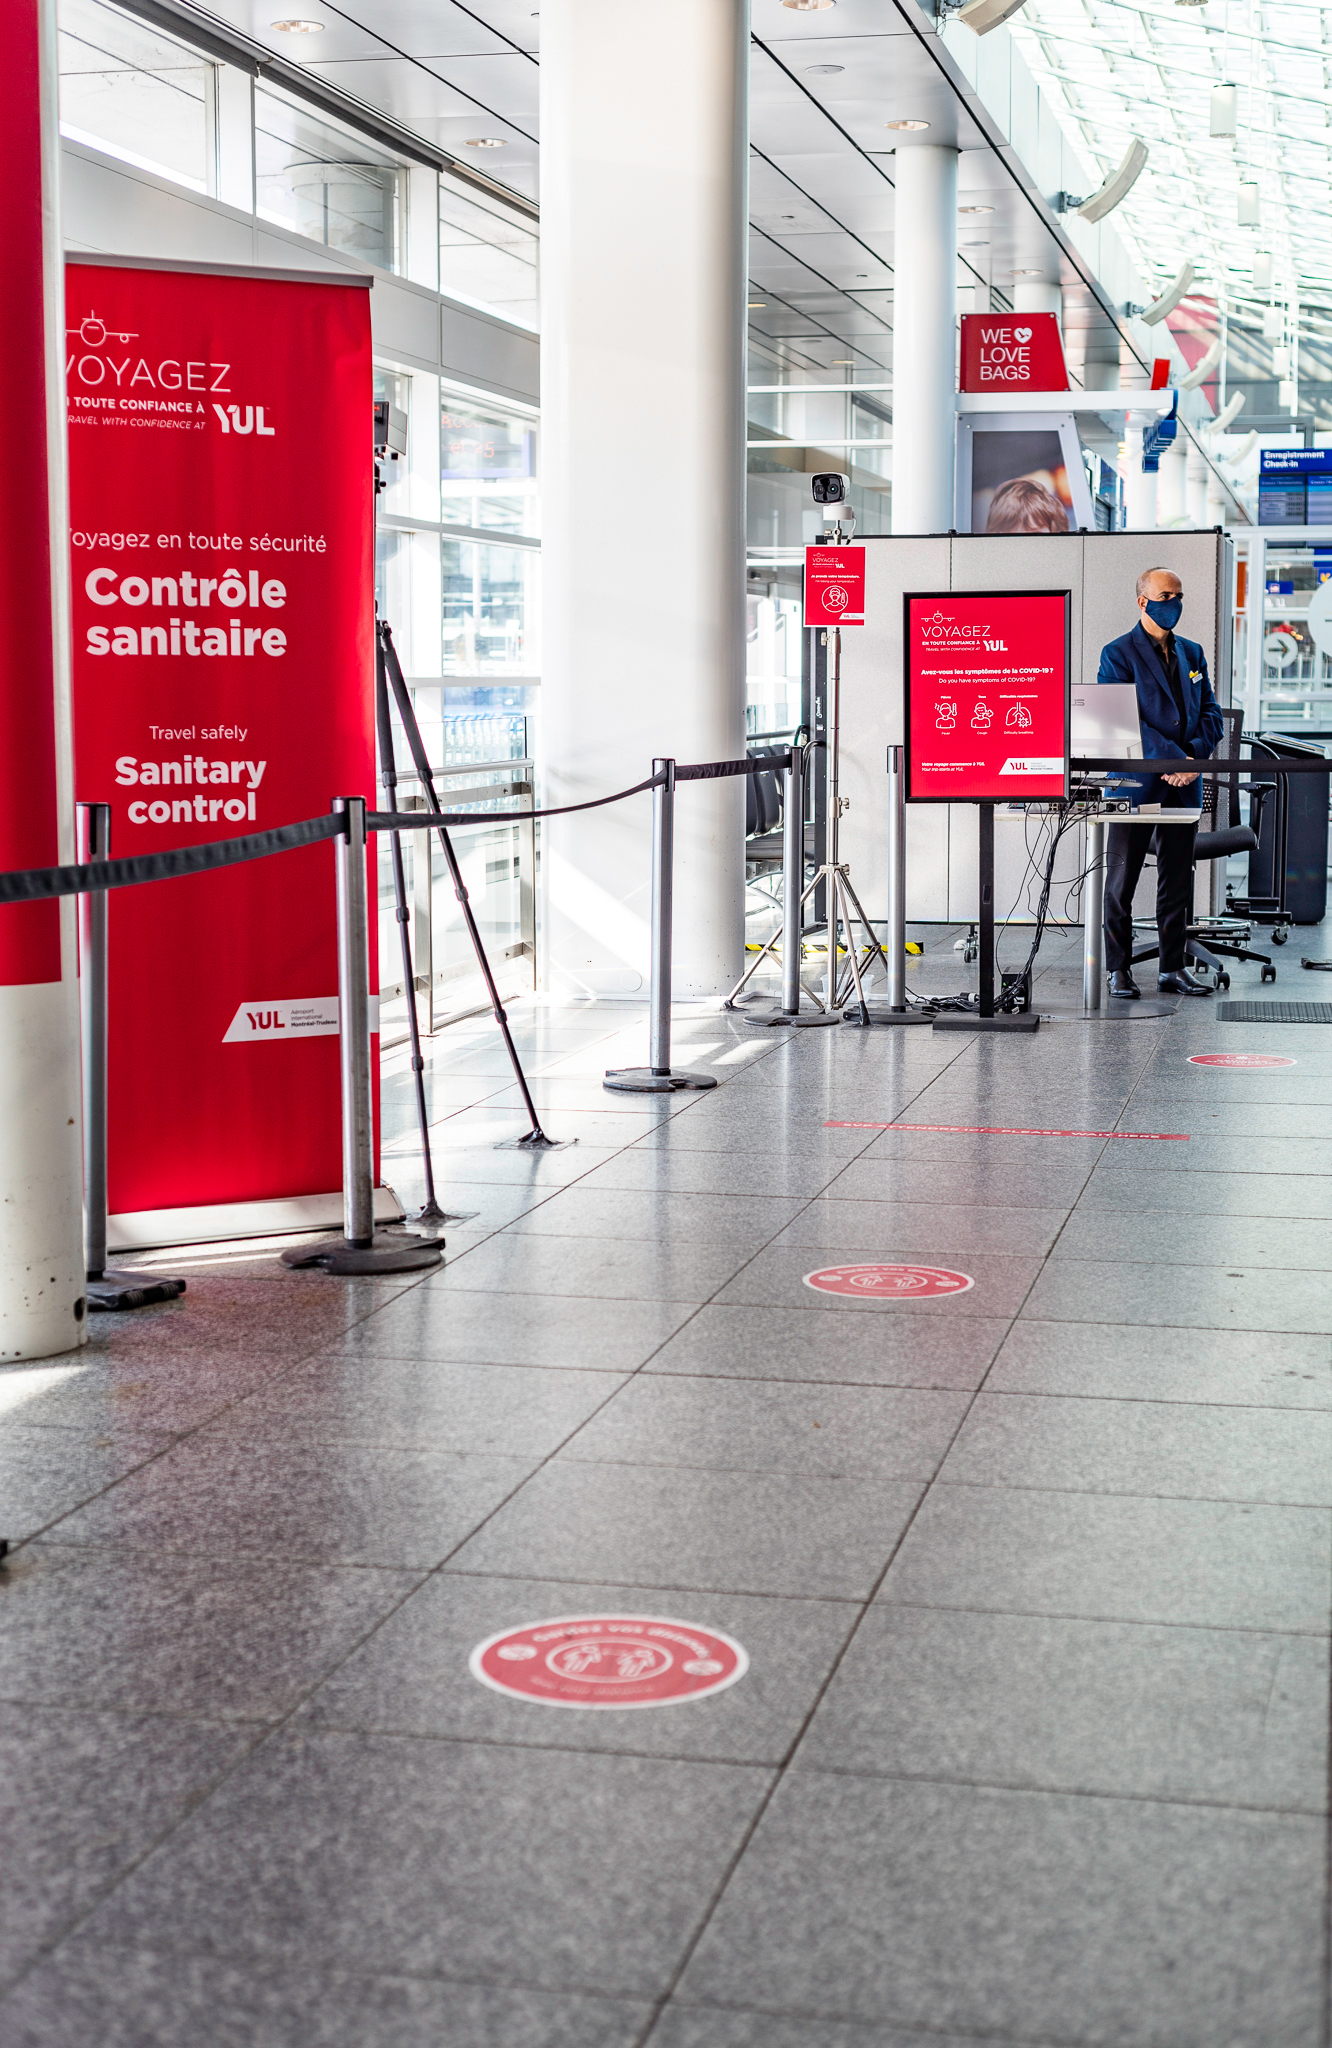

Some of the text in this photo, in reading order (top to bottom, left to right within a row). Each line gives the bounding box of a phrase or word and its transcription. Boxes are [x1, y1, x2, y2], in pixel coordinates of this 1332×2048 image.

[980, 328, 1012, 344] WE
[980, 346, 1031, 364] LOVE
[980, 365, 1031, 381] BAGS
[73, 396, 116, 409] TOUTE
[119, 399, 193, 414] CONFIANCE
[196, 401, 205, 414] À
[68, 414, 206, 430] RAVEL WITH CONFIDENCE AT
[212, 403, 275, 436] YUL
[1264, 451, 1325, 460] Enregistrement
[1263, 460, 1299, 469] Check-in
[69, 529, 327, 553] oyagez en toute sécurité
[85, 567, 287, 608] Contrôle
[86, 618, 288, 657] sanitaire
[921, 626, 991, 637] VOYAGEZ
[983, 640, 1008, 652] YUL
[964, 667, 1001, 676] symptômes
[972, 677, 1000, 685] symptoms
[149, 725, 248, 742] Travel safely
[115, 755, 267, 789] Sanitary
[1010, 762, 1028, 771] YUL
[128, 791, 257, 825] control
[246, 1010, 286, 1031] YUL
